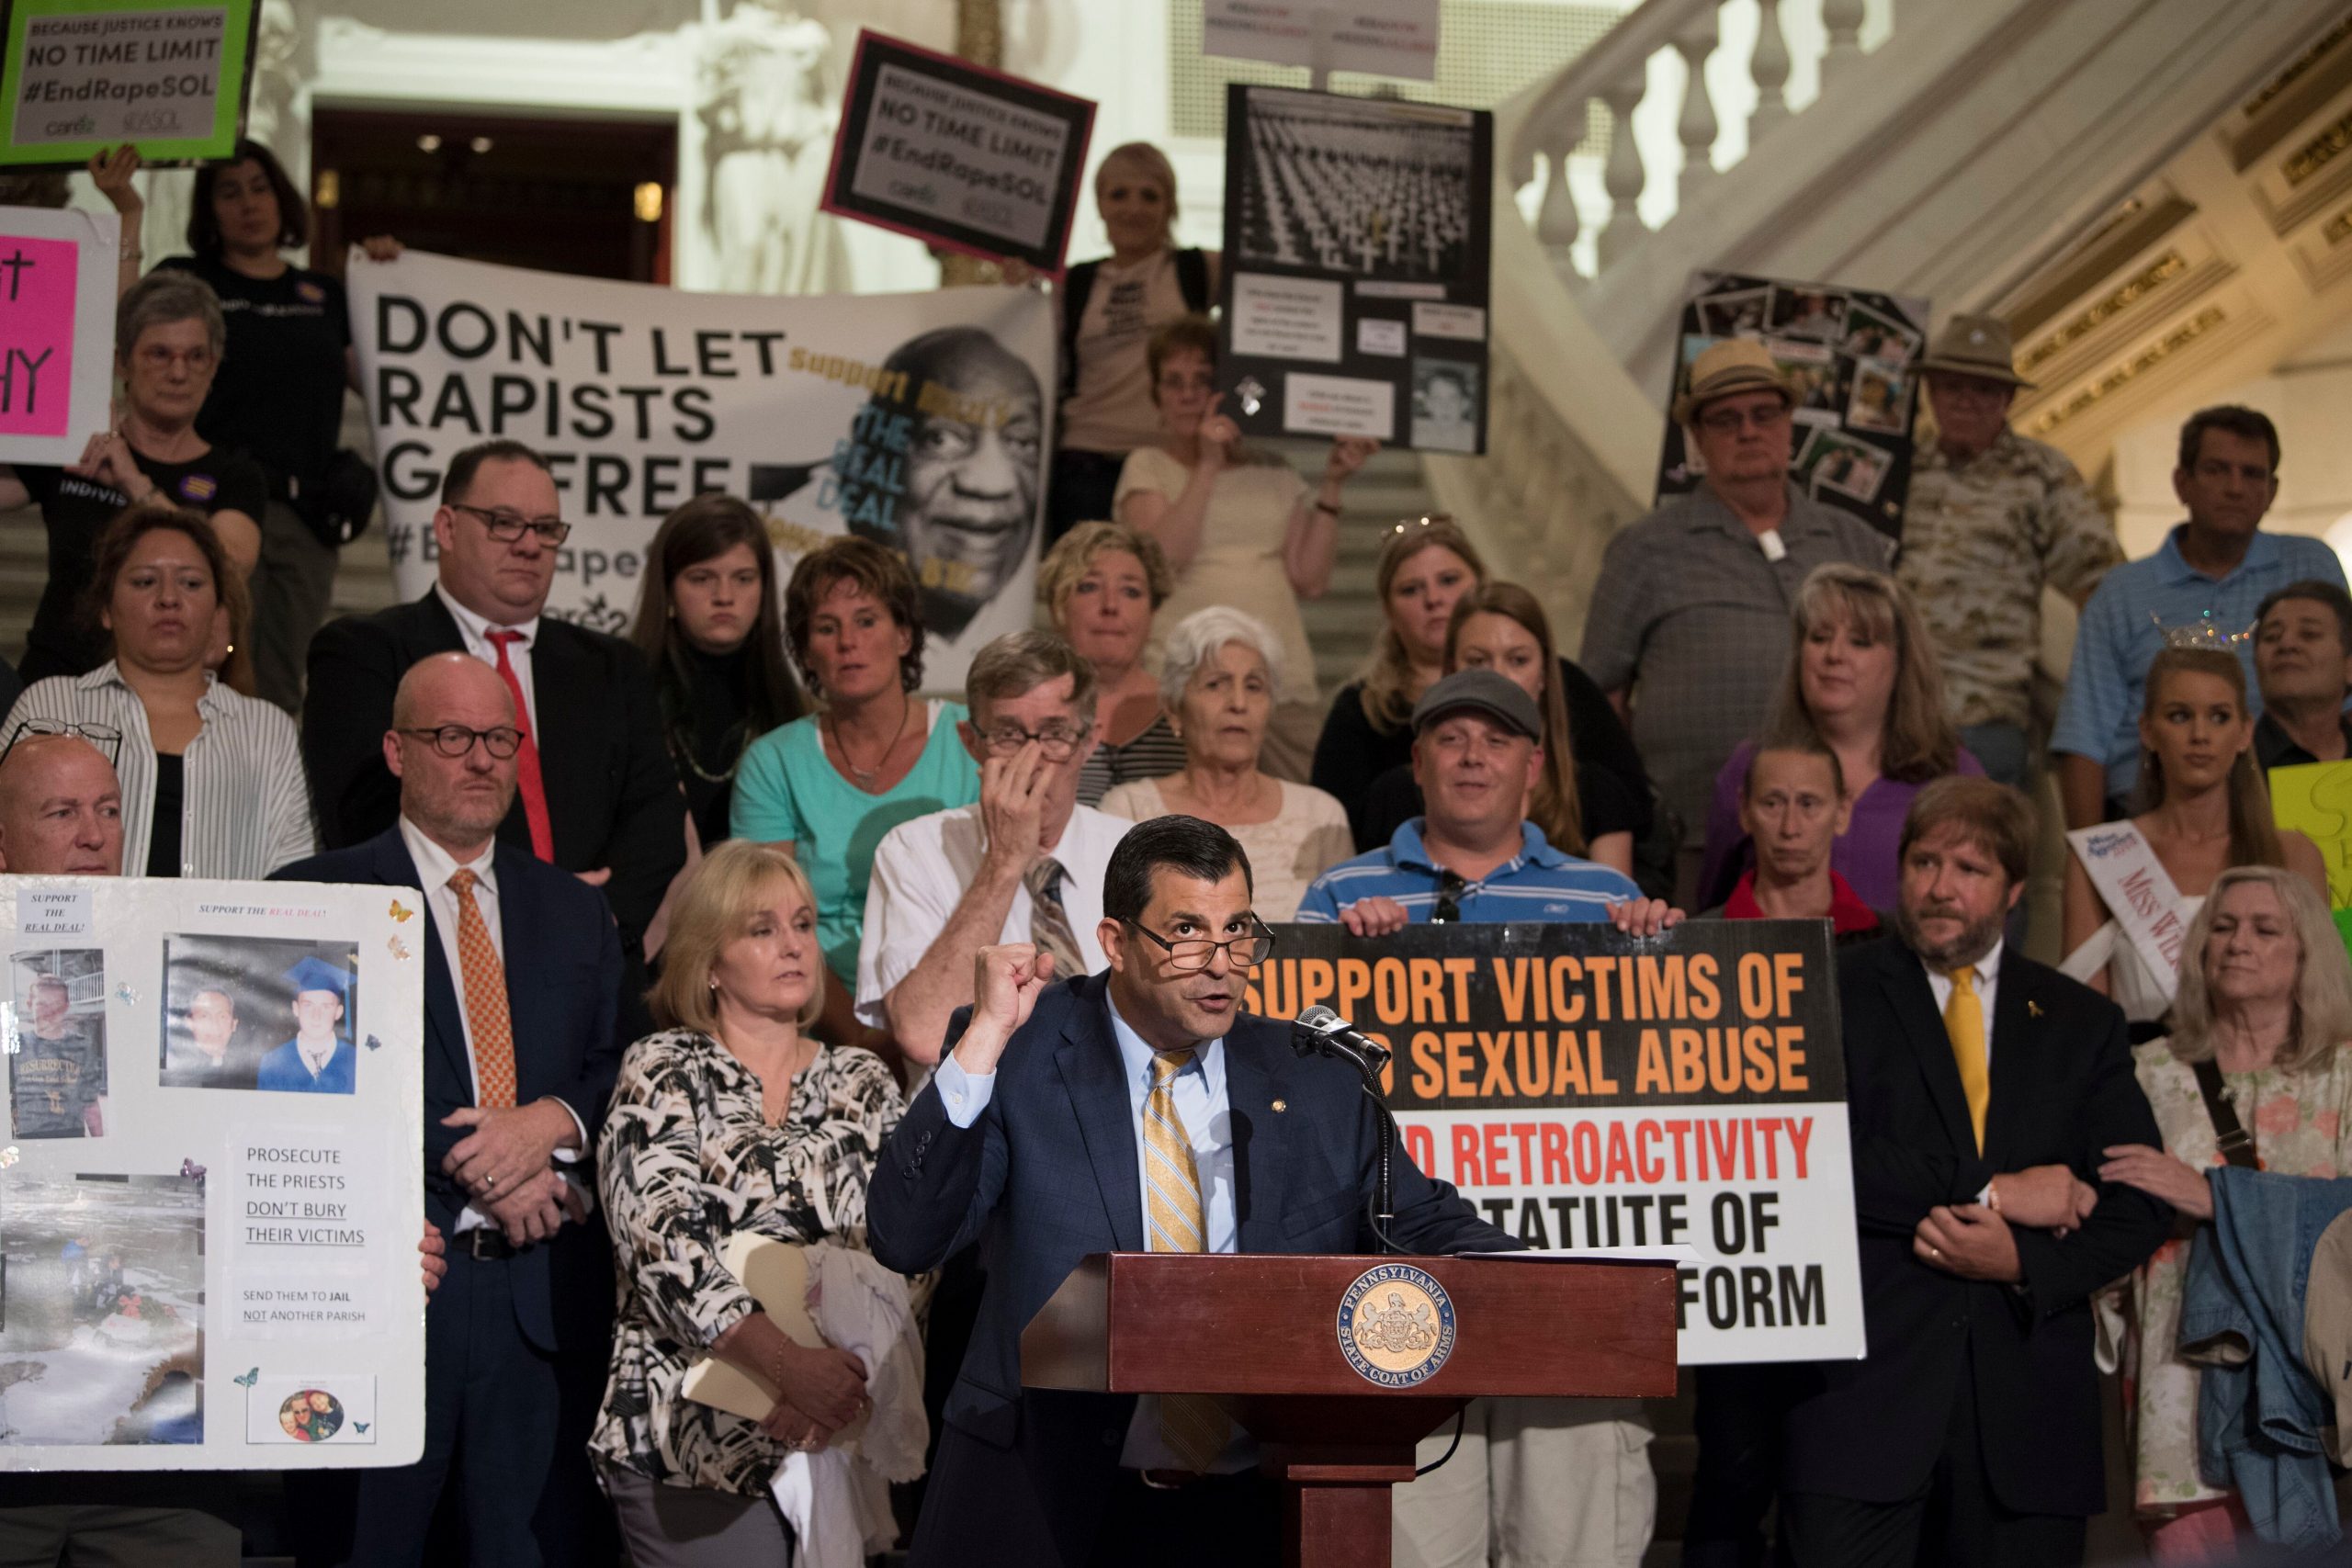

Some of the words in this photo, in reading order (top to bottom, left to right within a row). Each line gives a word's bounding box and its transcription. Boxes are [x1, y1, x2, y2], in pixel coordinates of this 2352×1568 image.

[31, 19, 98, 37] BECAUSE
[102, 17, 162, 35] JUSTICE
[167, 14, 223, 29] KNOWS
[28, 46, 66, 67] NO
[74, 42, 138, 64] TIME
[146, 39, 221, 62] LIMIT
[24, 74, 216, 104] #EndRapeSOL
[878, 97, 917, 126] NO
[923, 109, 984, 148] TIME
[989, 130, 1056, 168] LIMIT
[871, 135, 1047, 204] #EndRapeSOL
[377, 294, 622, 375] DON'T
[651, 328, 786, 378] LET
[378, 367, 716, 443] RAPISTS
[383, 440, 443, 501] G
[31, 894, 78, 903] SUPPORT
[45, 908, 65, 917] THE
[198, 904, 244, 914] SUPPORT
[247, 907, 266, 916] THE
[269, 908, 295, 917] REAL
[25, 923, 51, 932] REAL
[1239, 957, 1476, 1024] SUPPORT
[1492, 953, 1722, 1023] VICTIMS
[1737, 953, 1804, 1020] OF
[1410, 1030, 1619, 1099] SEXUAL
[1634, 1025, 1810, 1094] ABUSE
[247, 1147, 341, 1164] PROSECUTE
[1453, 1117, 1815, 1186] RETROACTIVITY
[247, 1173, 277, 1188] THE
[283, 1175, 345, 1190] PRIESTS
[304, 1203, 346, 1217] BURY
[1711, 1191, 1780, 1255] OF
[246, 1227, 293, 1242] THEIR
[298, 1229, 365, 1244] VICTIMS
[243, 1291, 273, 1301] SEND
[277, 1292, 308, 1301] THEM
[311, 1292, 326, 1302] TO
[329, 1292, 351, 1302] JAIL
[1343, 1266, 1447, 1311] PENNSYLVANIA
[243, 1310, 266, 1320] NOT
[270, 1311, 323, 1321] ANOTHER
[326, 1312, 366, 1322] PARISH
[1340, 1325, 1367, 1374] STATE
[1369, 1368, 1409, 1385] COAT
[1410, 1362, 1430, 1381] OF
[1430, 1325, 1453, 1368] ARMS
